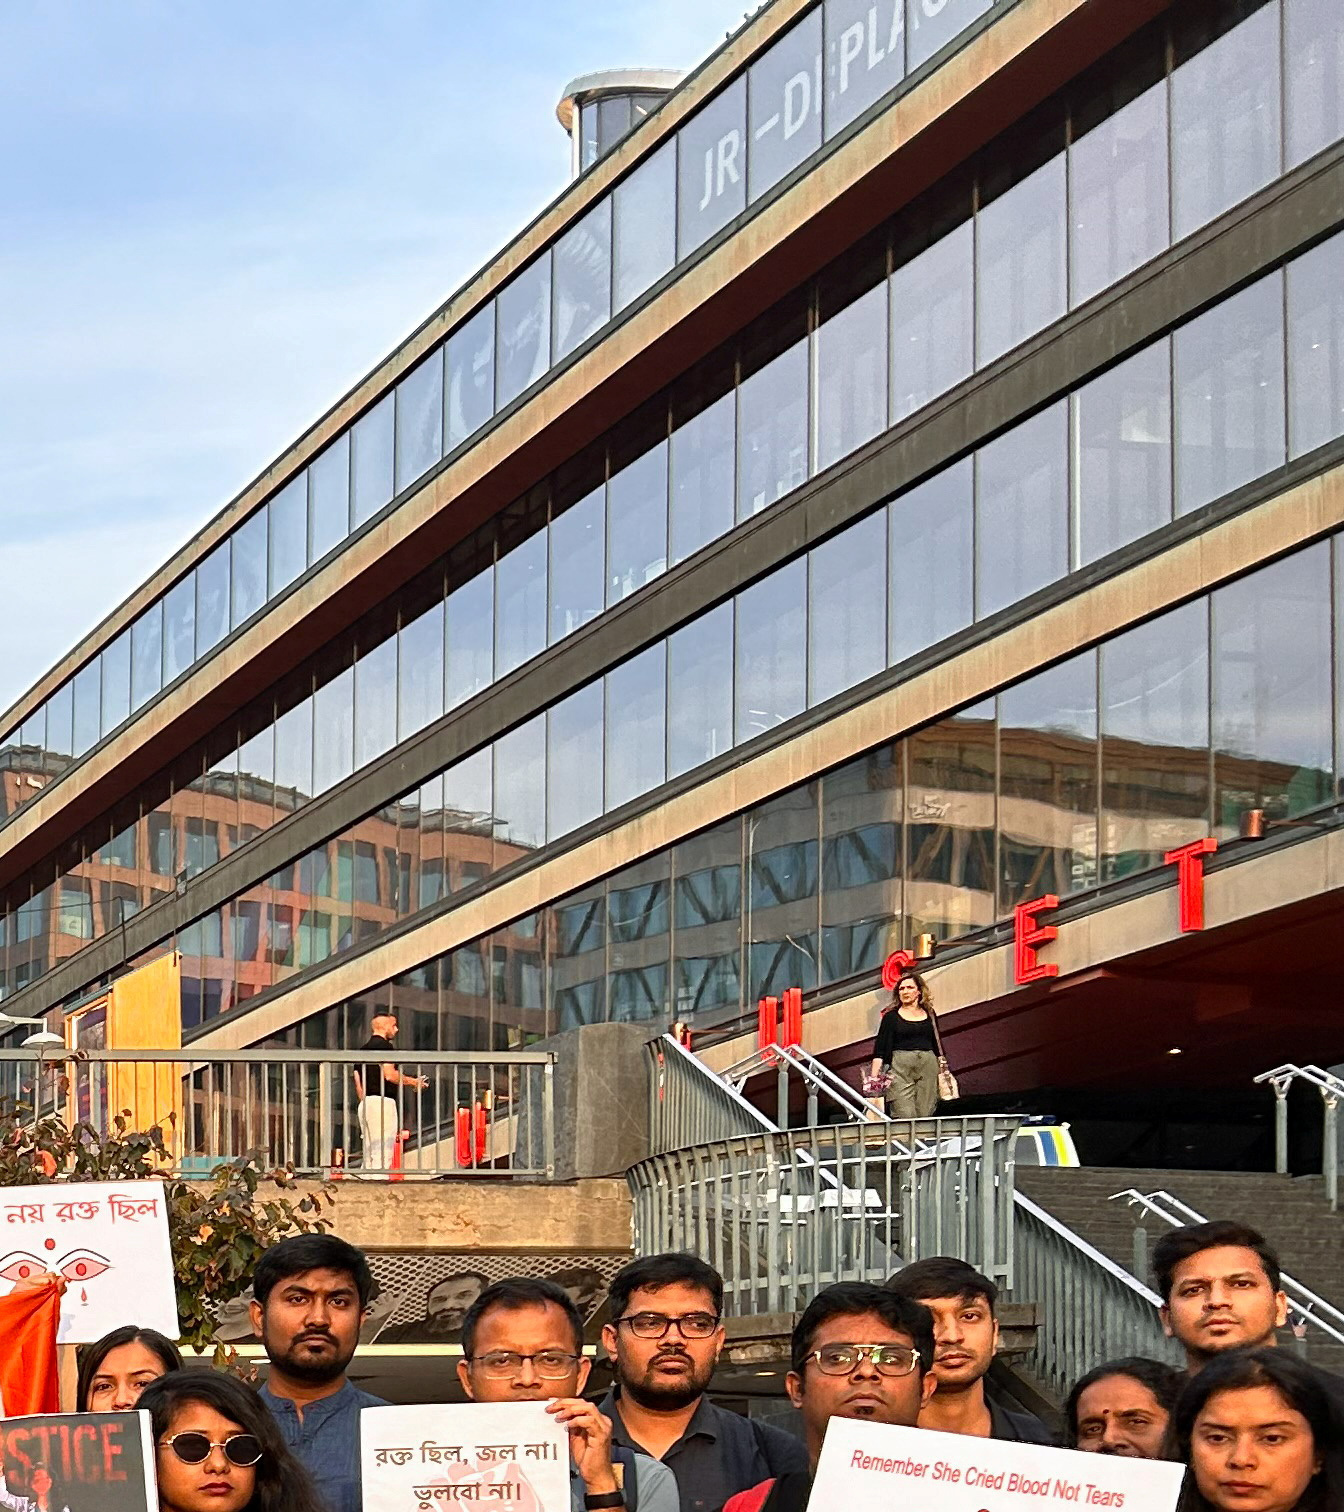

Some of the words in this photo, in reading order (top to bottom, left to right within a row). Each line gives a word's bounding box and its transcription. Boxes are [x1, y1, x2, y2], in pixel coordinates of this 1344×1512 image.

[5, 1203, 45, 1225] নয়
[53, 1201, 100, 1223] রক্ত
[108, 1194, 158, 1224] ছিল
[374, 1446, 414, 1467] রক্ত
[419, 1441, 469, 1467] ছিল,
[475, 1445, 517, 1463] জল
[525, 1443, 558, 1463] না।
[850, 1449, 931, 1481] Remember
[931, 1461, 962, 1487] She
[964, 1467, 1004, 1493] Cried
[1007, 1473, 1051, 1499] Blood
[1053, 1480, 1083, 1503] Not
[1085, 1484, 1125, 1508] Tears
[413, 1483, 481, 1511] ভুলবো
[488, 1483, 521, 1502] না।
